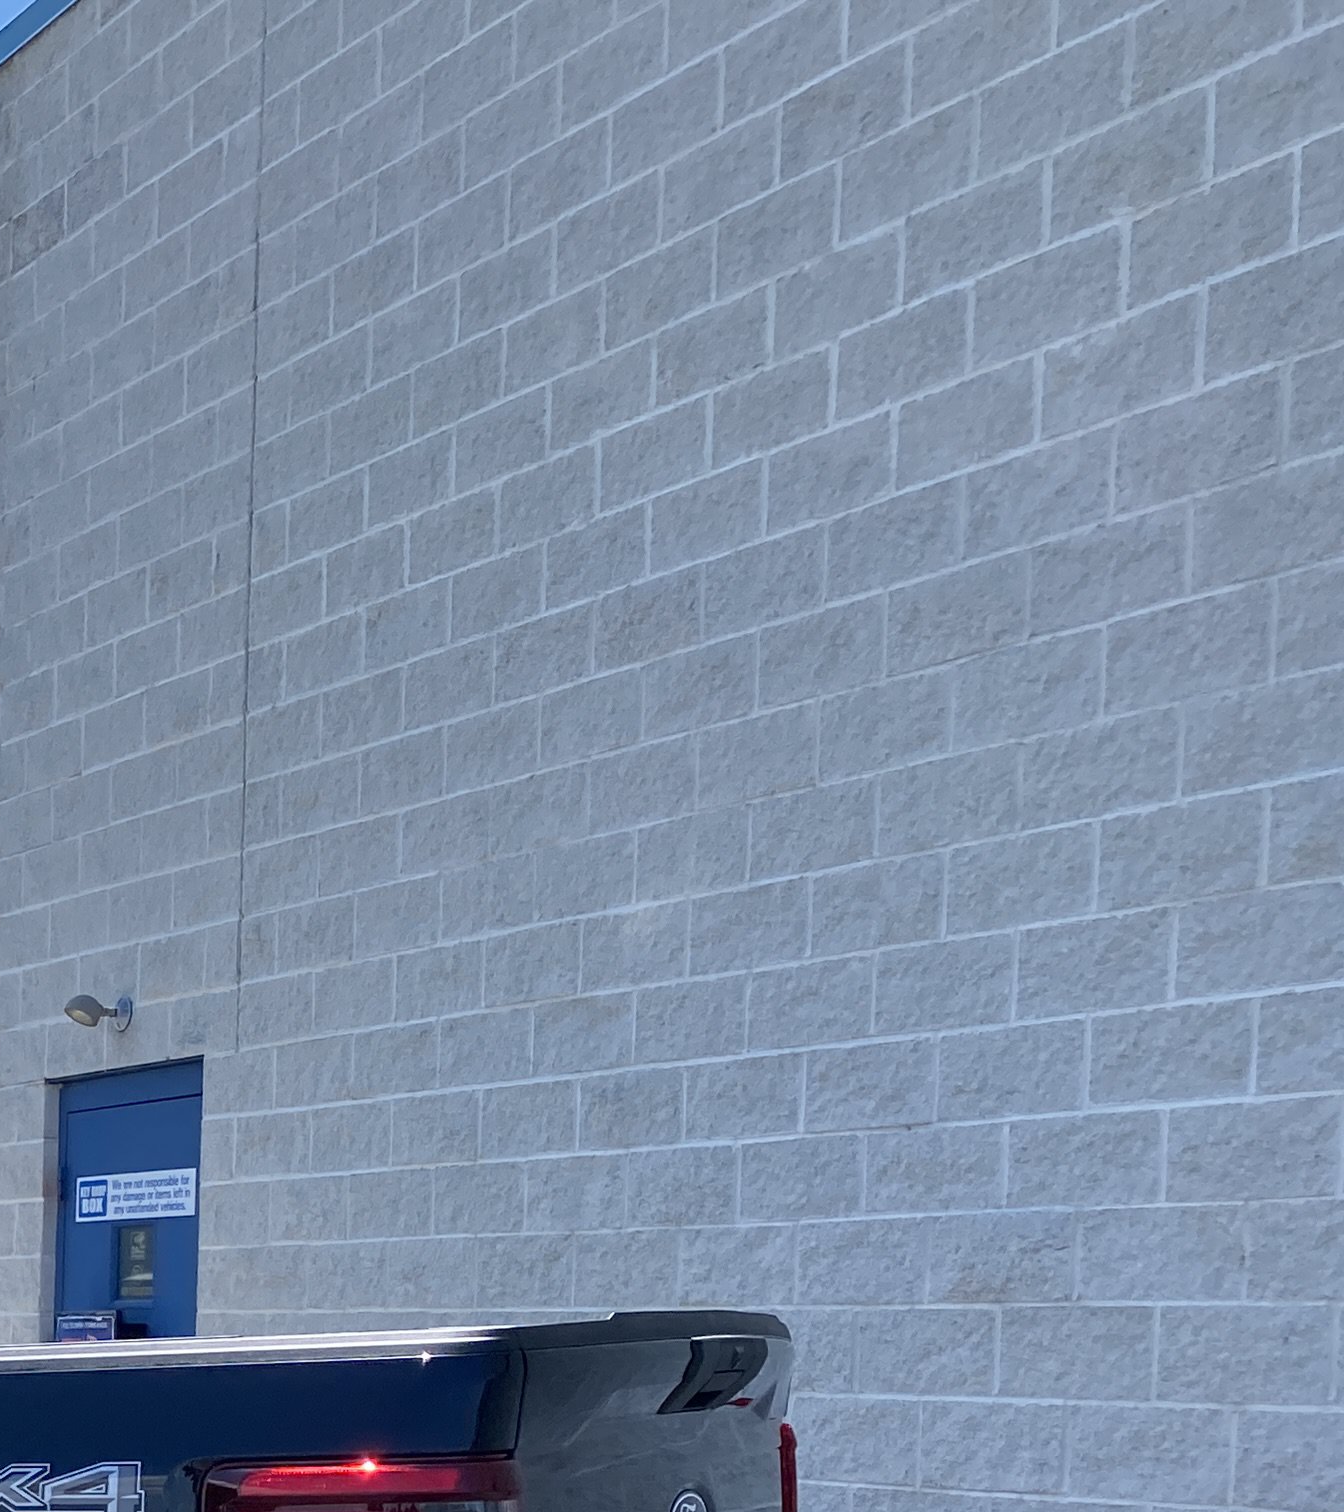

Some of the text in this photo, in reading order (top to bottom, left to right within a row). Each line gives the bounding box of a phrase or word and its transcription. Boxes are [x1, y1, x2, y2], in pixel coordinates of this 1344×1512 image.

[112, 1175, 189, 1190] We are not responsible for
[111, 1194, 121, 1204] any
[123, 1191, 146, 1203] damage
[155, 1190, 171, 1199] items
[173, 1188, 183, 1197] left
[81, 1197, 104, 1214] BOX
[114, 1206, 124, 1216] any
[126, 1203, 159, 1213] unattended
